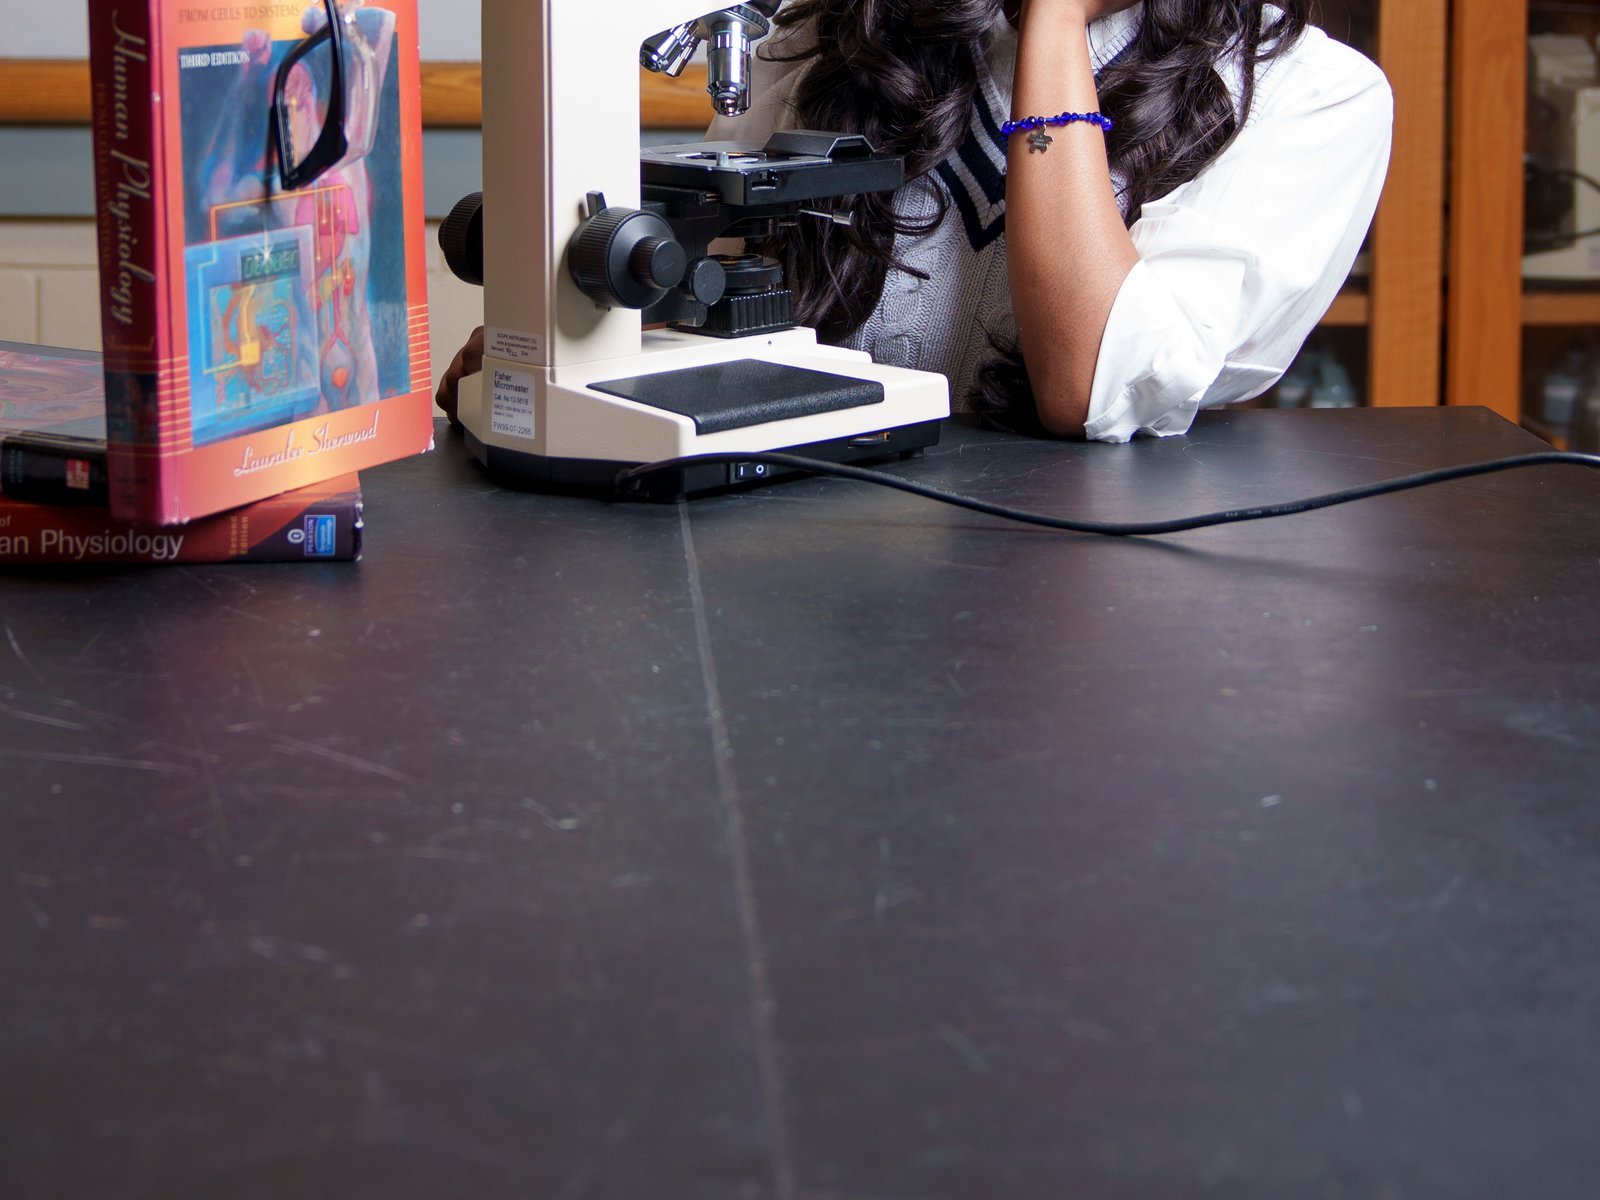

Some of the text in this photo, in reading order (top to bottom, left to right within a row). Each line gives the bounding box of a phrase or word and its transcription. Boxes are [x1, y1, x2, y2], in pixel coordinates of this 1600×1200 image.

[178, 3, 300, 24] FROM CELLS TO SYSTEMS
[180, 49, 250, 69] THIRD EDITION
[108, 8, 156, 325] Human Physiology
[494, 370, 512, 382] Fisher
[494, 380, 529, 394] Micromaster
[308, 408, 380, 456] Sherwood
[40, 528, 185, 561] Physiology
[229, 515, 238, 557] Second
[239, 516, 249, 555] Edition
